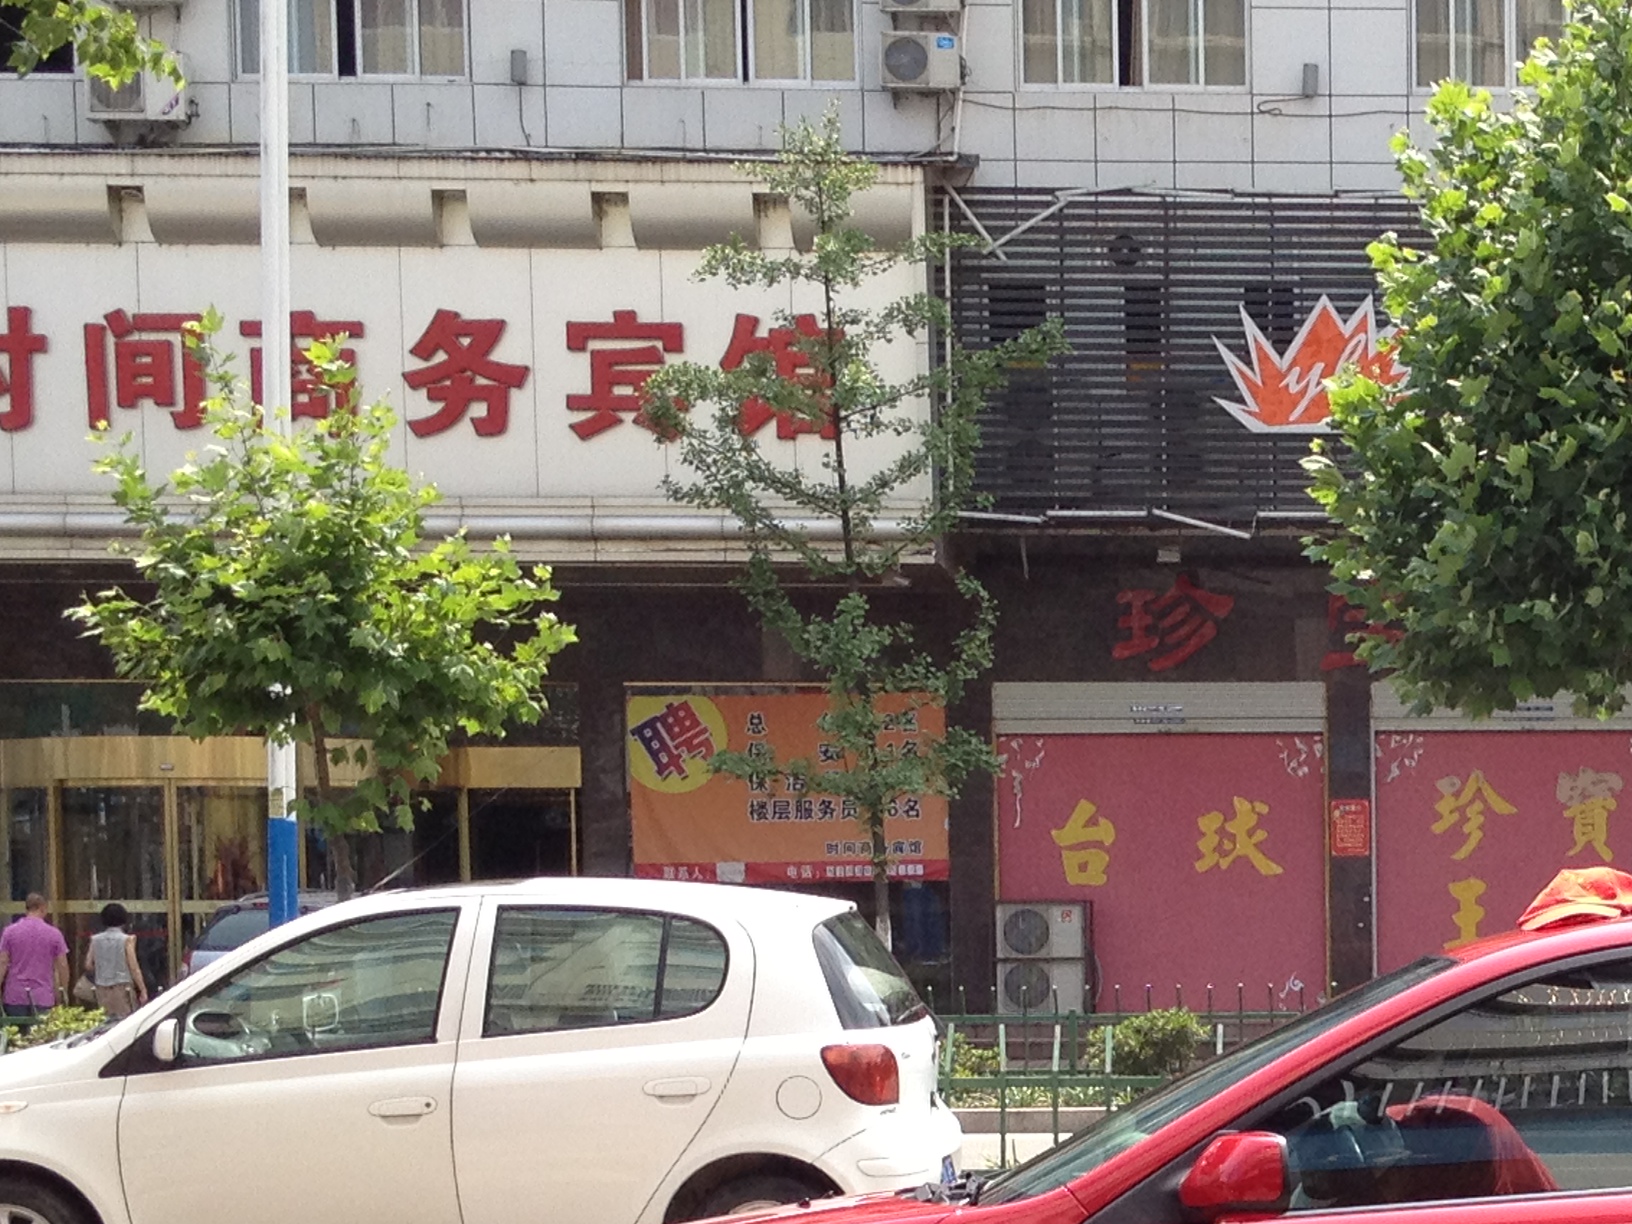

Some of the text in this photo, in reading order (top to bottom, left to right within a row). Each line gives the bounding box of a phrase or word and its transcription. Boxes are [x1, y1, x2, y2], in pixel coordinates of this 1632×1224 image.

[748, 798, 860, 821] 楼层服务员
[825, 840, 924, 857] 时间商宾馆
[1050, 795, 1285, 887] 台球
